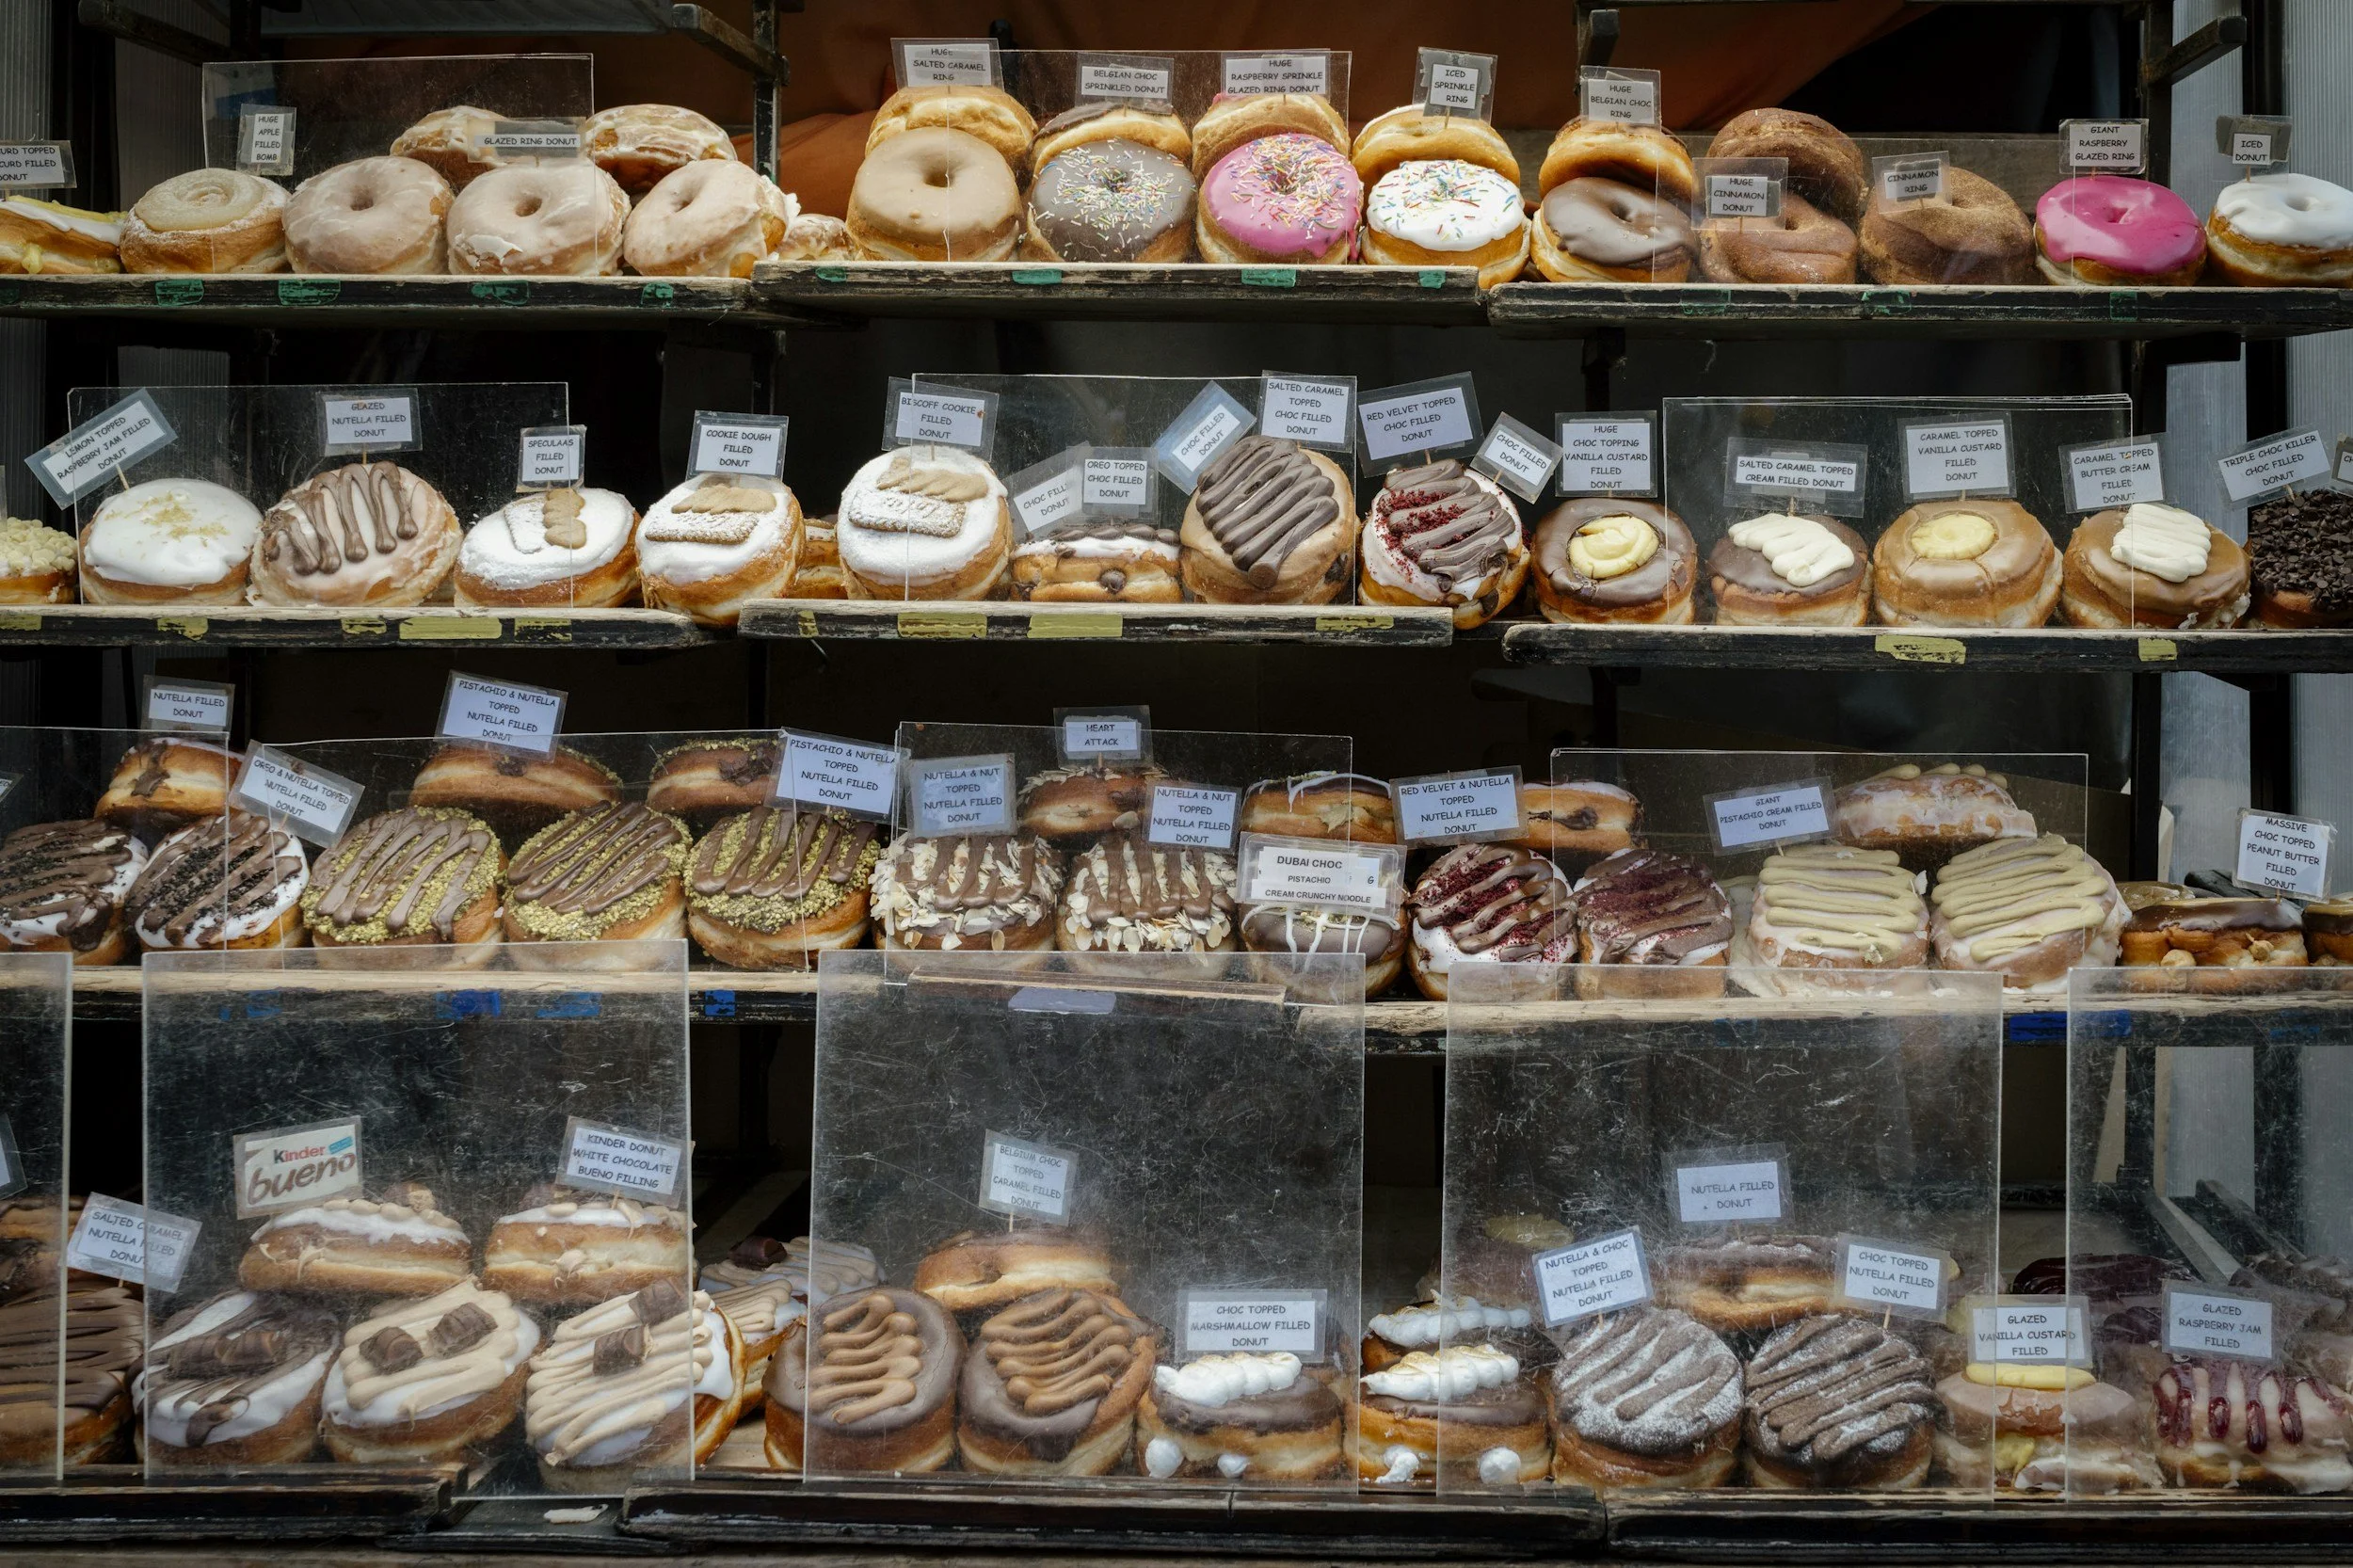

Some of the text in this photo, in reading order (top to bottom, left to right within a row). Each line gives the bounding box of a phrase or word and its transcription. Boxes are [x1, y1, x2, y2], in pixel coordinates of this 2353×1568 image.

[913, 59, 985, 71] SALTED CARAMEL
[1094, 69, 1131, 79] BELGIAN
[1445, 69, 1465, 77] ICED
[1084, 82, 1165, 93] SPRINKLED DONUT
[1289, 85, 1320, 93] DONUT
[1433, 81, 1475, 91] SPRINKLE
[1609, 85, 1631, 93] HUGE
[1446, 94, 1468, 103] RING
[1590, 96, 1652, 107] BELGIAN CHOC
[1609, 109, 1631, 118] RING
[1729, 177, 1753, 186] HUGE
[1713, 189, 1764, 200] CINNAMON
[1722, 203, 1753, 212] DONUT
[1268, 382, 1344, 396] SALTED CARAMEL
[1289, 397, 1321, 408] TOPPED
[1366, 396, 1455, 421] RED VELVET TOPPED
[331, 414, 407, 424] NUTELLA FILLED
[920, 415, 952, 425] FILLED
[1274, 410, 1332, 423] CHOC FILLED
[1384, 414, 1441, 431] CHOC FILLED
[354, 428, 386, 437] DONUT
[919, 428, 951, 439] DONUT
[1286, 424, 1318, 435] DONUT
[1593, 424, 1618, 433] HUGE
[1920, 428, 1998, 440] CARAMEL TOPPED
[706, 430, 772, 440] COOKIE DOUGH
[1401, 428, 1433, 441] DONUT
[527, 439, 573, 447] SPECULAAS
[1573, 439, 1640, 447] CHOC TOPPING
[1917, 442, 2002, 455] VANILLA CUSTARD
[723, 444, 753, 454] FILLED
[1497, 434, 1546, 469] CHOC FILLED
[2223, 436, 2316, 468] TRIPLE CHOC KILLER
[536, 452, 564, 461] FILLED
[719, 457, 750, 467] DONUT
[1499, 451, 1529, 472] DONUT
[1945, 457, 1977, 467] FILLED
[535, 466, 564, 474] DONUT
[1086, 460, 1144, 471] OREO TOPPED
[1591, 466, 1622, 474] FILLED
[1738, 459, 1853, 475] SALTED CARAMEL TOPPED
[2245, 454, 2304, 476] CHOC FILLED
[1087, 474, 1143, 485] CHOC FILLED
[1745, 473, 1845, 488] CREAM FILLED DONUT
[1945, 472, 1977, 481] DONUT
[2262, 470, 2294, 486] DONUT
[1590, 480, 1622, 488] DONUT
[1099, 488, 1129, 497] DONUT
[153, 692, 225, 707] NUTELLA FILLED
[172, 708, 203, 718] DONUT
[824, 760, 858, 773] TOPPED
[801, 770, 878, 791] NUTELLA FILLED
[1401, 786, 1418, 795] RED
[1421, 782, 1455, 793] VELVET
[1468, 776, 1510, 788] NUTELLA
[818, 788, 853, 800] DONUT
[1439, 794, 1474, 805] TOPPED
[1177, 805, 1212, 815] TOPPED
[1420, 807, 1497, 822] NUTELLA FILLED
[1152, 817, 1232, 833] NUTELLA FILLED
[1444, 823, 1477, 834] DONUT
[2265, 816, 2310, 832] MASSIVE
[1176, 833, 1209, 843] DONUT
[2254, 830, 2315, 849] CHOC TOPPED
[2247, 842, 2319, 865] PEANUT BUTTER
[1276, 856, 1342, 869] DUBAI CHOC
[2265, 862, 2297, 876] FILLED
[1288, 875, 1331, 884] PISTACHIO
[2264, 876, 2296, 889] DONUT
[1264, 888, 1370, 903] CREAM CRUNCHY NOODLE
[587, 1134, 666, 1156] KINDER DONUT
[274, 1146, 327, 1163] Kinder
[572, 1147, 672, 1175] WHITE CHOCOLATE
[248, 1151, 357, 1206] bueno
[578, 1165, 659, 1188] BUENO FILLING
[1690, 1180, 1774, 1193] NUTELLA FILLED
[1717, 1198, 1753, 1208] DONUT
[1216, 1304, 1286, 1314] CHOC TOPPED
[2202, 1304, 2242, 1316] GLAZED
[2007, 1314, 2047, 1324] GLAZED
[1191, 1320, 1310, 1330] MARSHMALLOW FILLED
[2178, 1318, 2261, 1335] RASPBERRY JAM
[1232, 1336, 1269, 1346] DONUT
[2204, 1336, 2240, 1348] FILLED
[2011, 1346, 2048, 1355] FILLED
